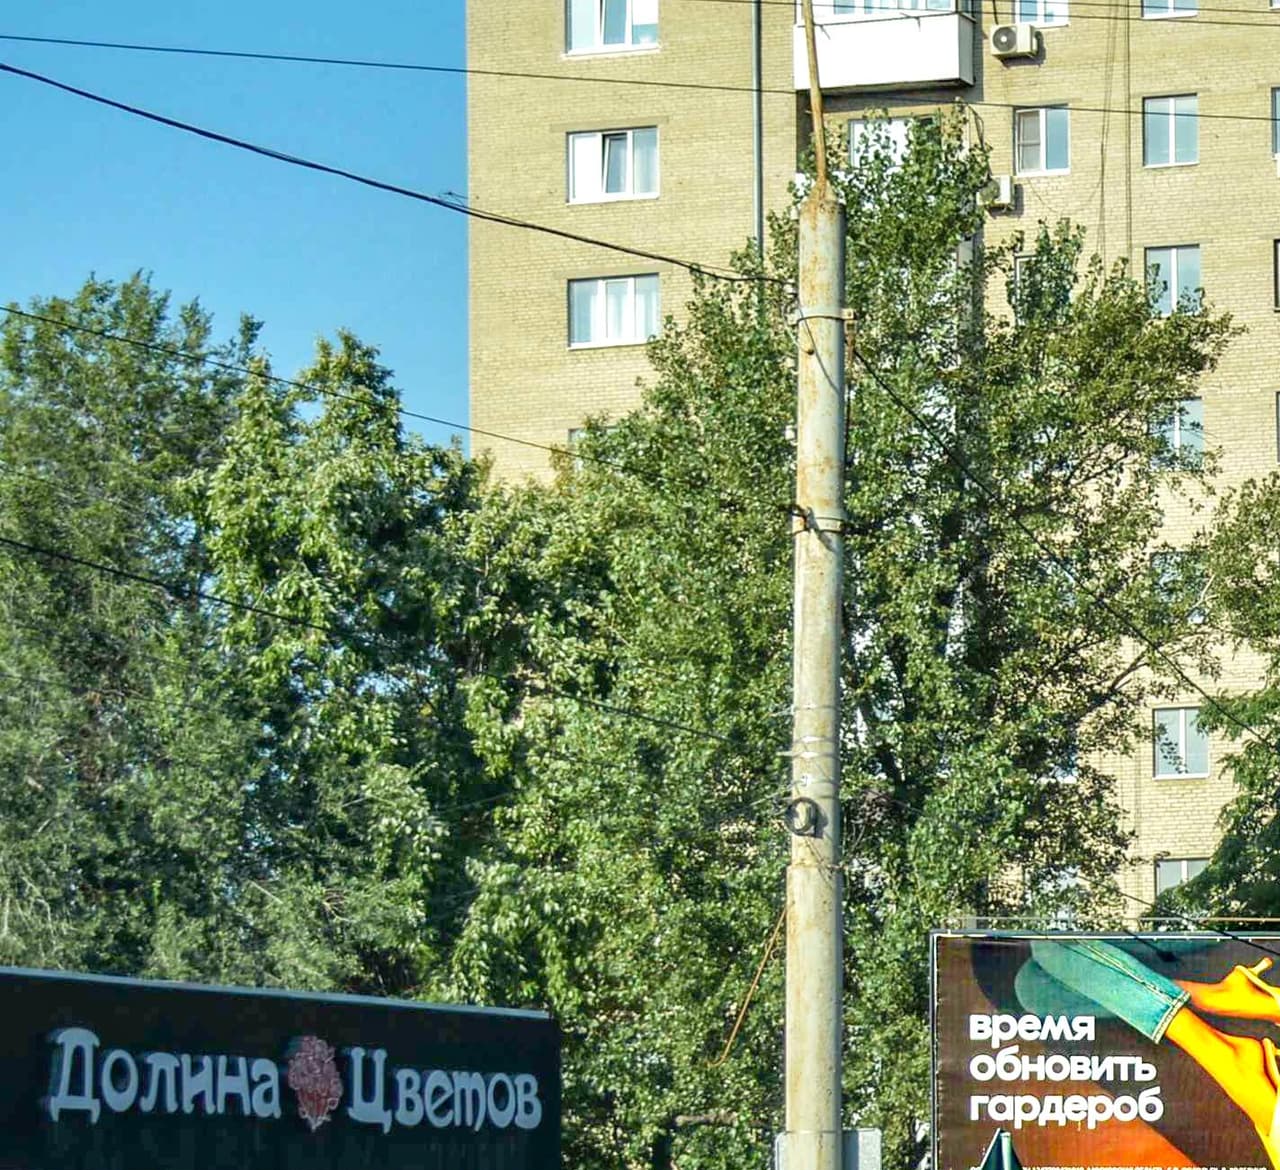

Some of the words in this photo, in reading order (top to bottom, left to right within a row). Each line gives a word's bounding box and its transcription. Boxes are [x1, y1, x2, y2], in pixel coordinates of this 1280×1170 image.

[969, 1014, 1096, 1049] время
[49, 1027, 282, 1125] Долина
[346, 1047, 542, 1135] Цветов
[969, 1045, 1157, 1081] обновить
[970, 1086, 1164, 1130] гардероб
